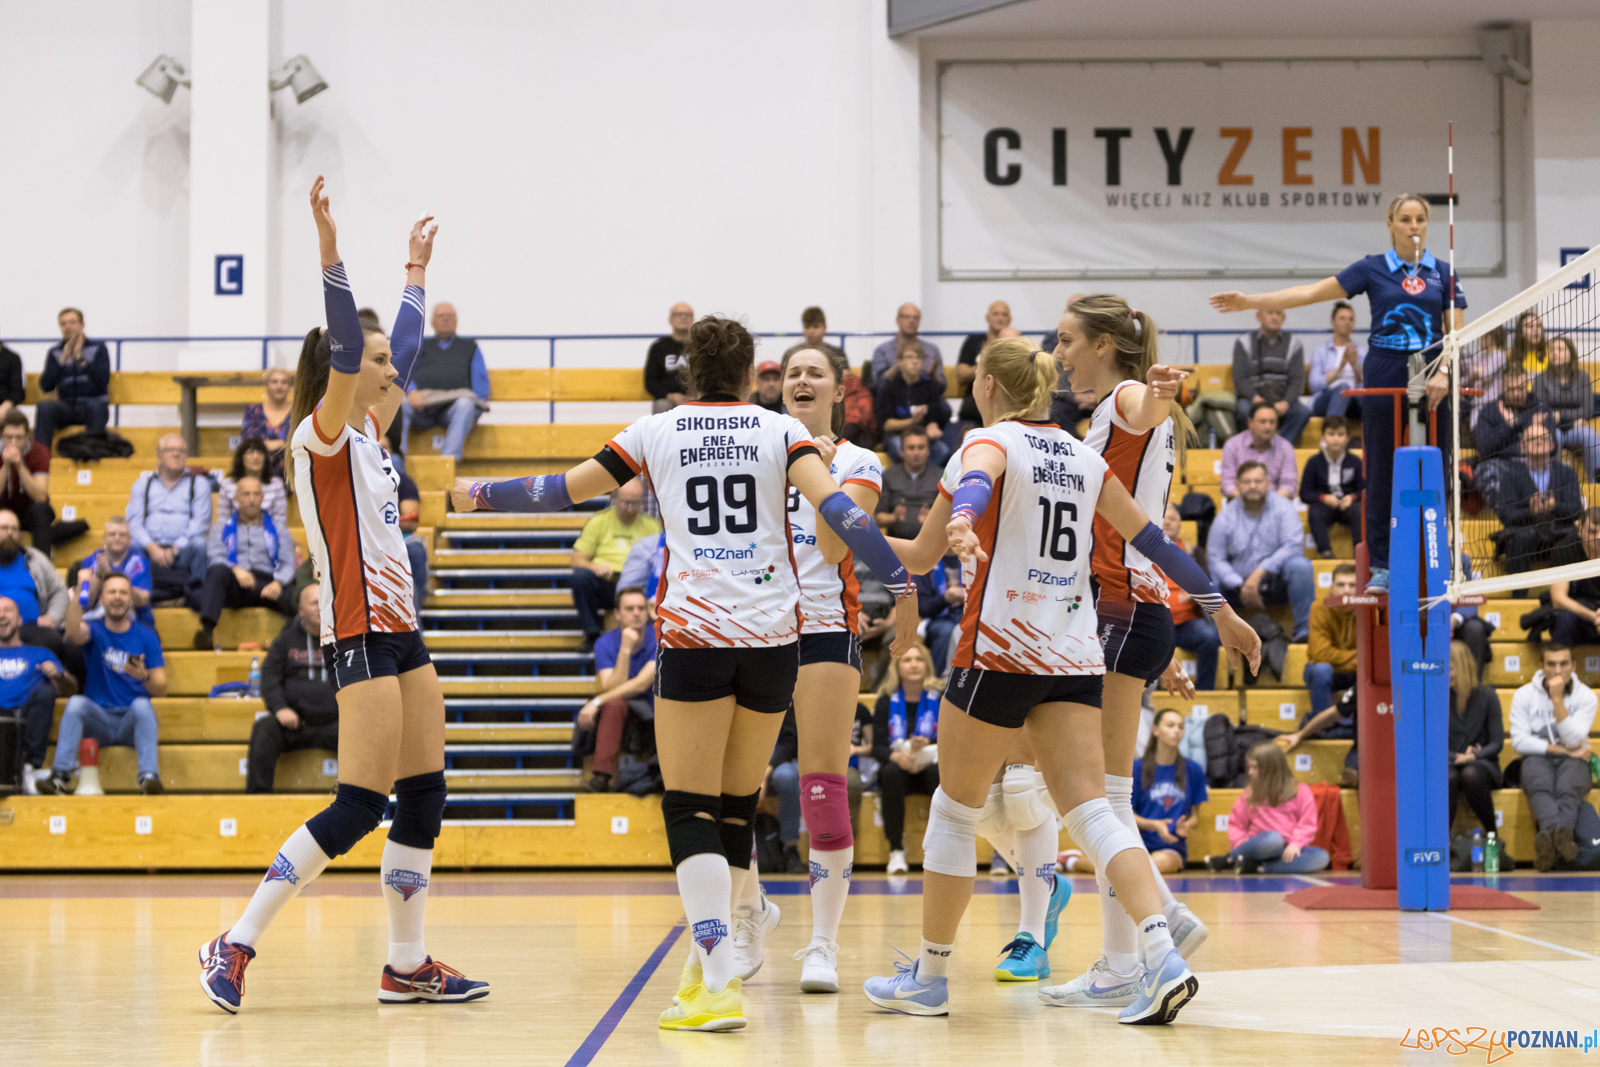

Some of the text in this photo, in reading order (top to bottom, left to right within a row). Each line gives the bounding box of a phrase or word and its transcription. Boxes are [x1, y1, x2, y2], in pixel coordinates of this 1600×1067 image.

[983, 127, 1381, 186] CITYZEN
[1106, 192, 1172, 210] WIĘCEJ
[1222, 191, 1270, 207] KLUB
[1280, 191, 1382, 207] SPORTOWY
[664, 354, 689, 371] EA
[676, 416, 761, 432] SIKORSKA
[703, 435, 735, 447] ENEA
[1024, 433, 1075, 456] TOBIASZ
[680, 445, 759, 467] ENERGETYK
[1043, 458, 1066, 473] ENEA
[1032, 465, 1085, 493] ENERGETYK
[685, 474, 758, 536] 99
[1038, 495, 1078, 562] 16
[344, 649, 355, 668] 7
